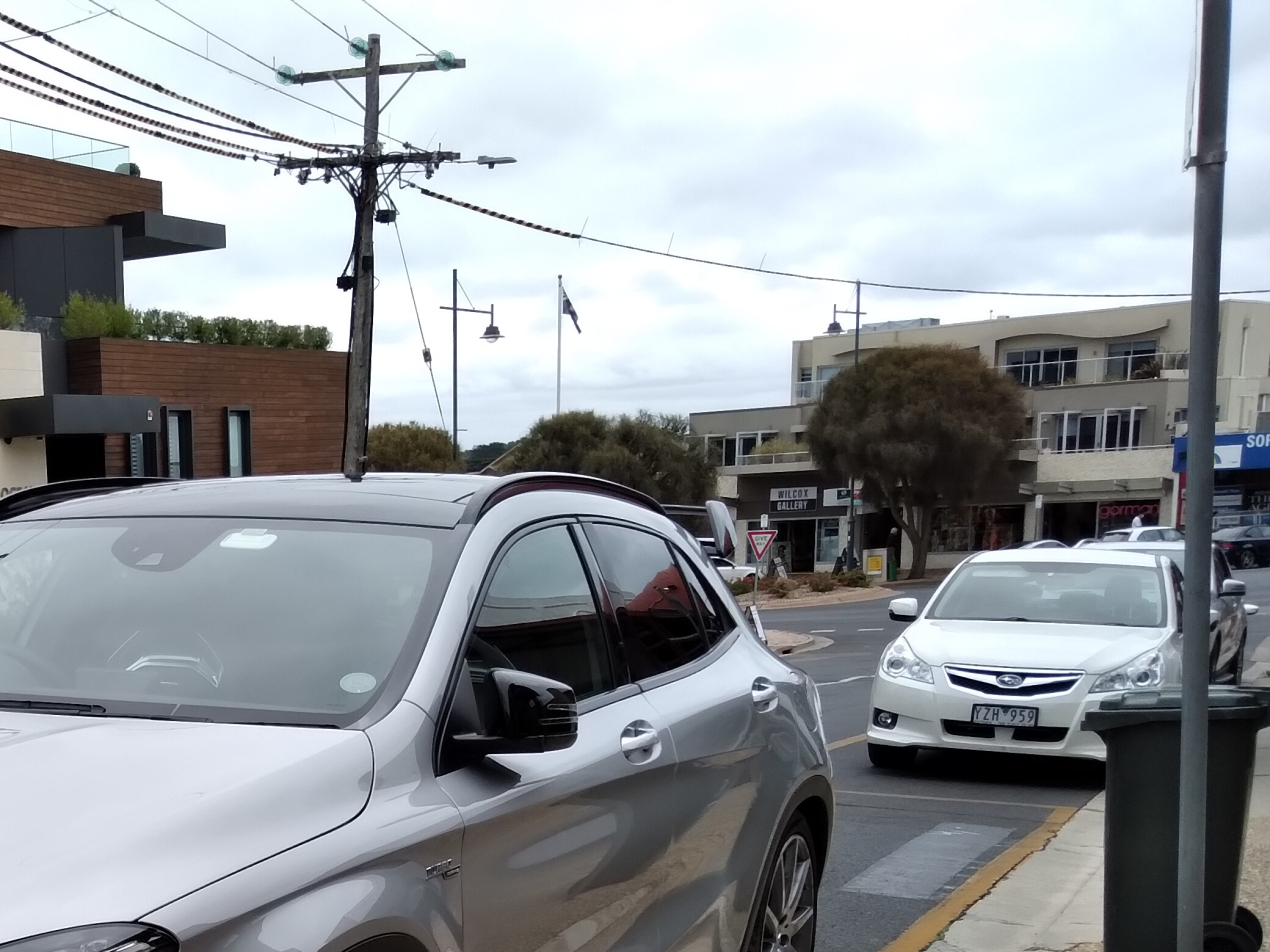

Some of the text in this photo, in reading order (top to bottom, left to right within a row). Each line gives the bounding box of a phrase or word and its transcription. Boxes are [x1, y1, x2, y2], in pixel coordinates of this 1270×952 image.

[778, 488, 809, 499] WILCOX
[777, 500, 808, 511] GALLERY
[1099, 504, 1159, 519] gorman
[974, 707, 1035, 723] YZH 959
